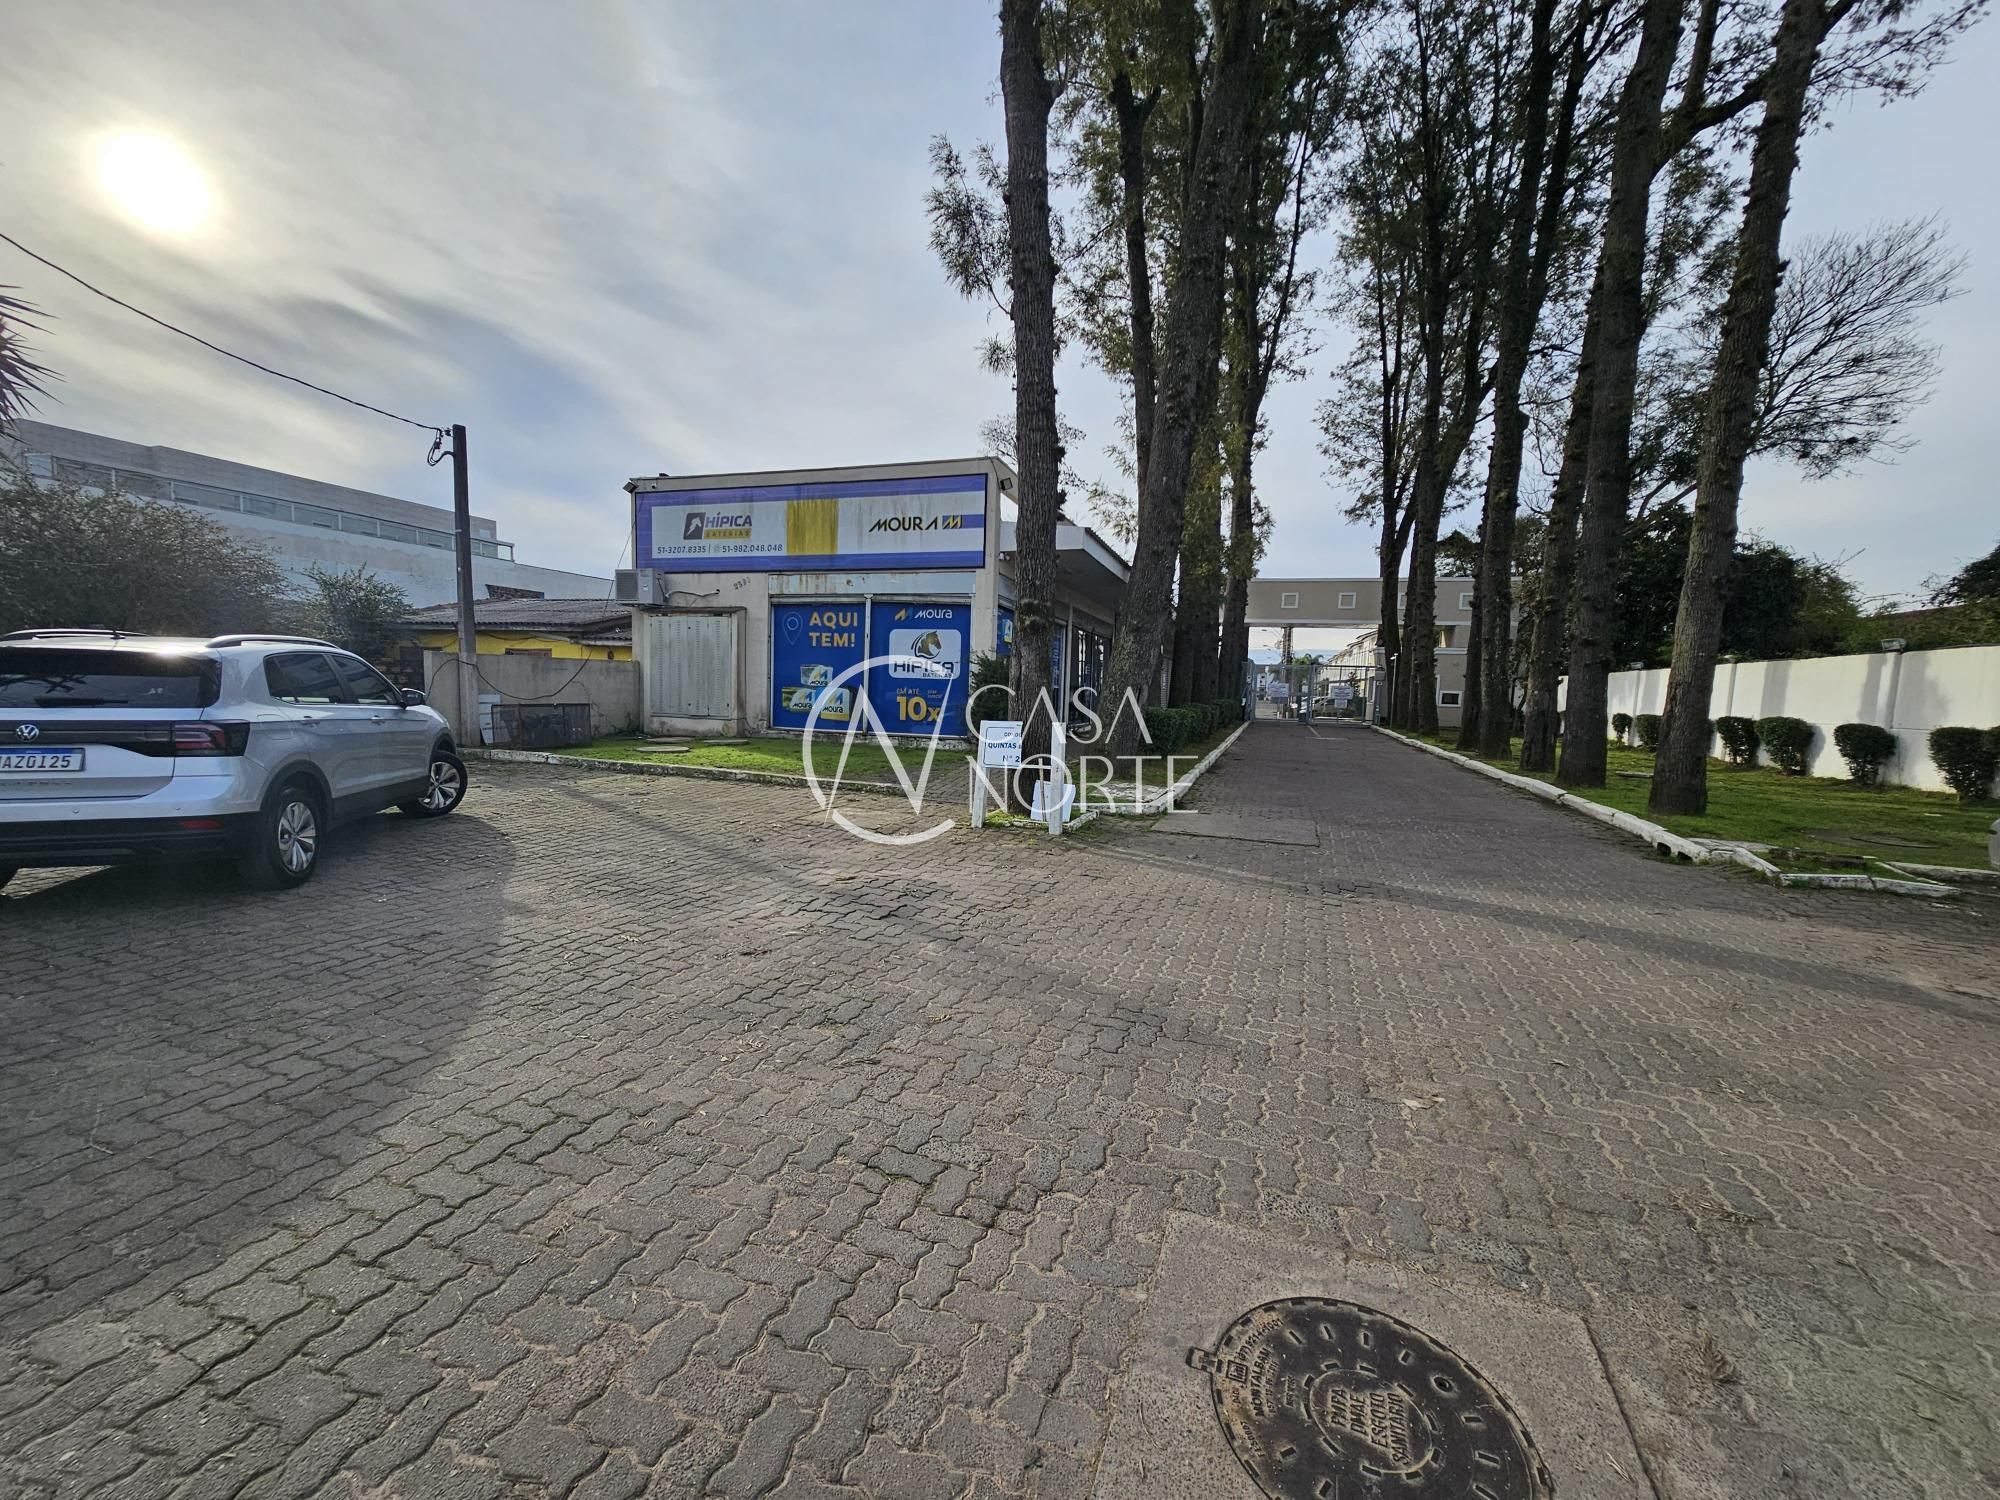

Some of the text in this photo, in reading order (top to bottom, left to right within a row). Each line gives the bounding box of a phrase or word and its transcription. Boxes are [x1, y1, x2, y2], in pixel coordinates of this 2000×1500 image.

[705, 512, 752, 528] HÍPICA
[869, 516, 938, 532] MOURA
[705, 530, 750, 538] BATERIAS
[657, 543, 783, 554] 51-3207.8335 51-982.048.048
[809, 611, 858, 629] AQUI
[809, 632, 855, 648] TEM!
[988, 742, 1017, 750] QUINTAS
[1330, 1389, 1347, 1428] PMPA
[1350, 1392, 1368, 1436] DMAE
[1370, 1392, 1388, 1449] ESGOTO
